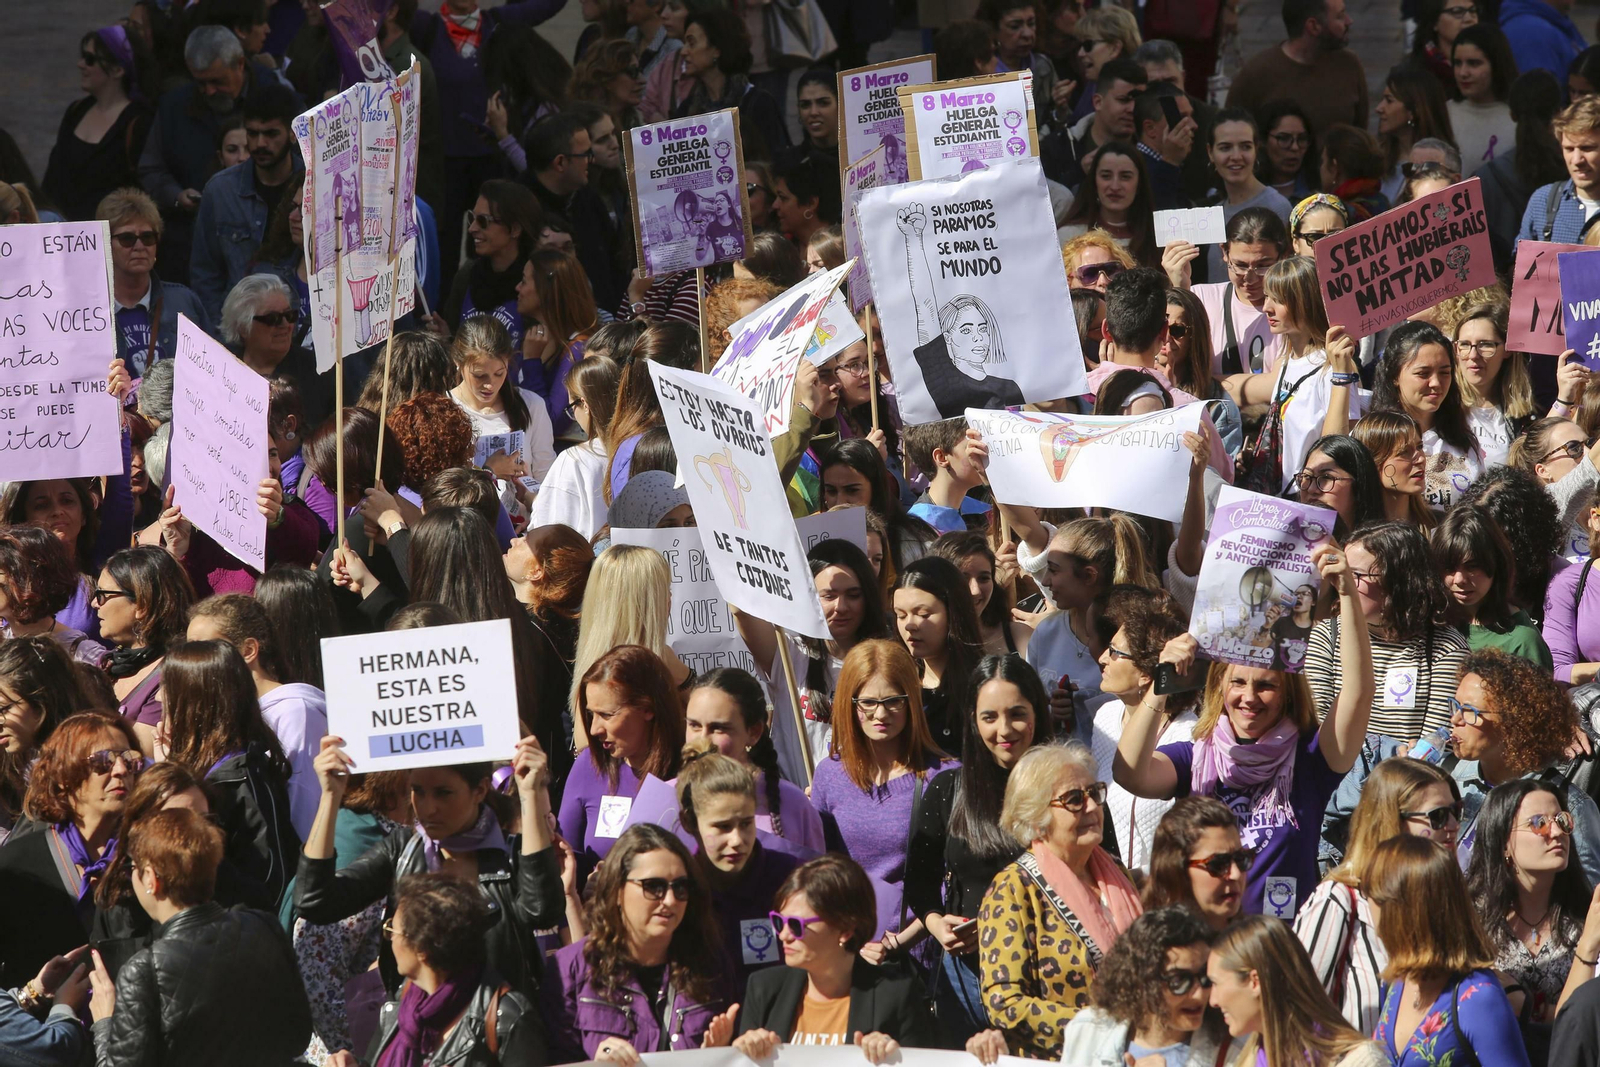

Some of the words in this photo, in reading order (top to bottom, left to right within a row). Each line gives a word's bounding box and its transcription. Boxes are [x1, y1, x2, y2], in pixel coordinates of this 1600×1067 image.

[850, 77, 861, 92] 8
[866, 72, 909, 88] Marzo
[922, 95, 935, 111] 8
[940, 92, 996, 108] Marzo
[946, 105, 998, 121] HUELGA
[641, 130, 653, 145] 8
[657, 124, 708, 143] Marzo
[934, 130, 1001, 146] ESTUDIANTIL
[941, 118, 1000, 134] GENERAL
[657, 149, 711, 167] GENERAL
[662, 137, 709, 155] HUELGA
[650, 160, 712, 179] ESTUDIANTIL
[857, 161, 876, 180] Marzo
[931, 205, 941, 216] SI
[944, 199, 993, 215] NOSOTRAS
[0, 241, 12, 257] O
[43, 231, 97, 254] ESTÁN
[937, 242, 952, 255] SE
[954, 240, 980, 253] PARA
[984, 237, 998, 251] EL
[1330, 203, 1431, 273] SERÍAMOS
[941, 256, 1002, 279] MUNDO
[1326, 273, 1353, 301] NO
[1357, 255, 1390, 286] LAS
[0, 314, 26, 337] AS
[42, 307, 107, 333] VOCES
[182, 333, 215, 377] Mientras
[245, 393, 263, 413] una
[50, 383, 65, 394] LA
[71, 380, 107, 393] TUMB
[0, 408, 16, 420] SE
[37, 403, 75, 416] PUEDE
[659, 376, 701, 412] ESTOY
[705, 398, 755, 432] HASTA
[185, 388, 205, 415] mujer
[214, 411, 254, 449] sometida
[1000, 421, 1011, 434] O
[1012, 422, 1041, 434] CON
[0, 424, 91, 451] itar
[681, 408, 705, 432] LOS
[713, 419, 766, 456] OVARIOS
[184, 427, 195, 441] no
[231, 464, 249, 484] una
[987, 438, 1023, 457] AGINA
[183, 464, 206, 495] mujer
[1229, 508, 1296, 533] Combativas
[1244, 496, 1280, 515] Libres
[1283, 509, 1293, 521] y
[714, 530, 733, 553] DE
[735, 537, 789, 572] TANTOS
[1240, 534, 1295, 551] FEMINISMO
[1215, 552, 1222, 560] y
[1226, 552, 1312, 575] ANTICAPITALISTA
[736, 561, 793, 601] COJONES
[681, 599, 722, 634] QUE
[1200, 633, 1213, 649] 8
[1218, 637, 1274, 659] Marzo
[360, 646, 479, 674] HERMANA,
[377, 678, 432, 700] ESTA
[439, 674, 466, 693] ES
[372, 701, 477, 728] NUESTRA
[389, 730, 465, 753] LUCHA
